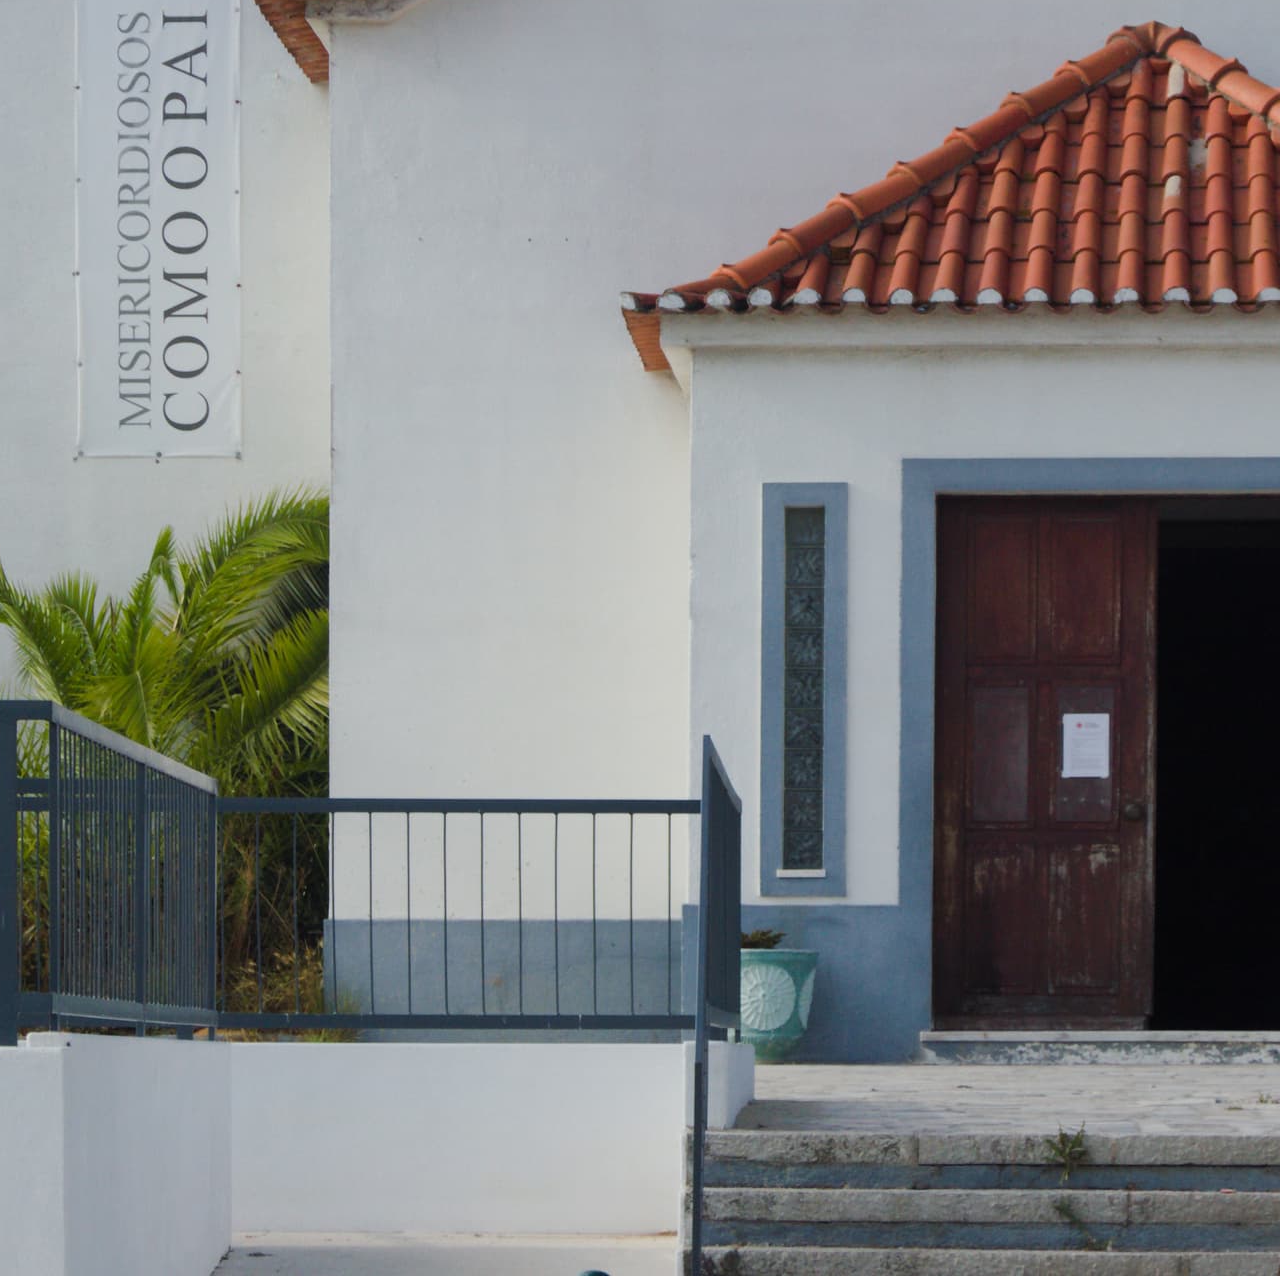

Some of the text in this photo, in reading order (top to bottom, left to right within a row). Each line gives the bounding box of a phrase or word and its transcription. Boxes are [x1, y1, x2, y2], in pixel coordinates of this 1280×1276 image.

[117, 12, 151, 429] MISERICORDIOSOS
[161, 10, 209, 432] COMO O PAI
